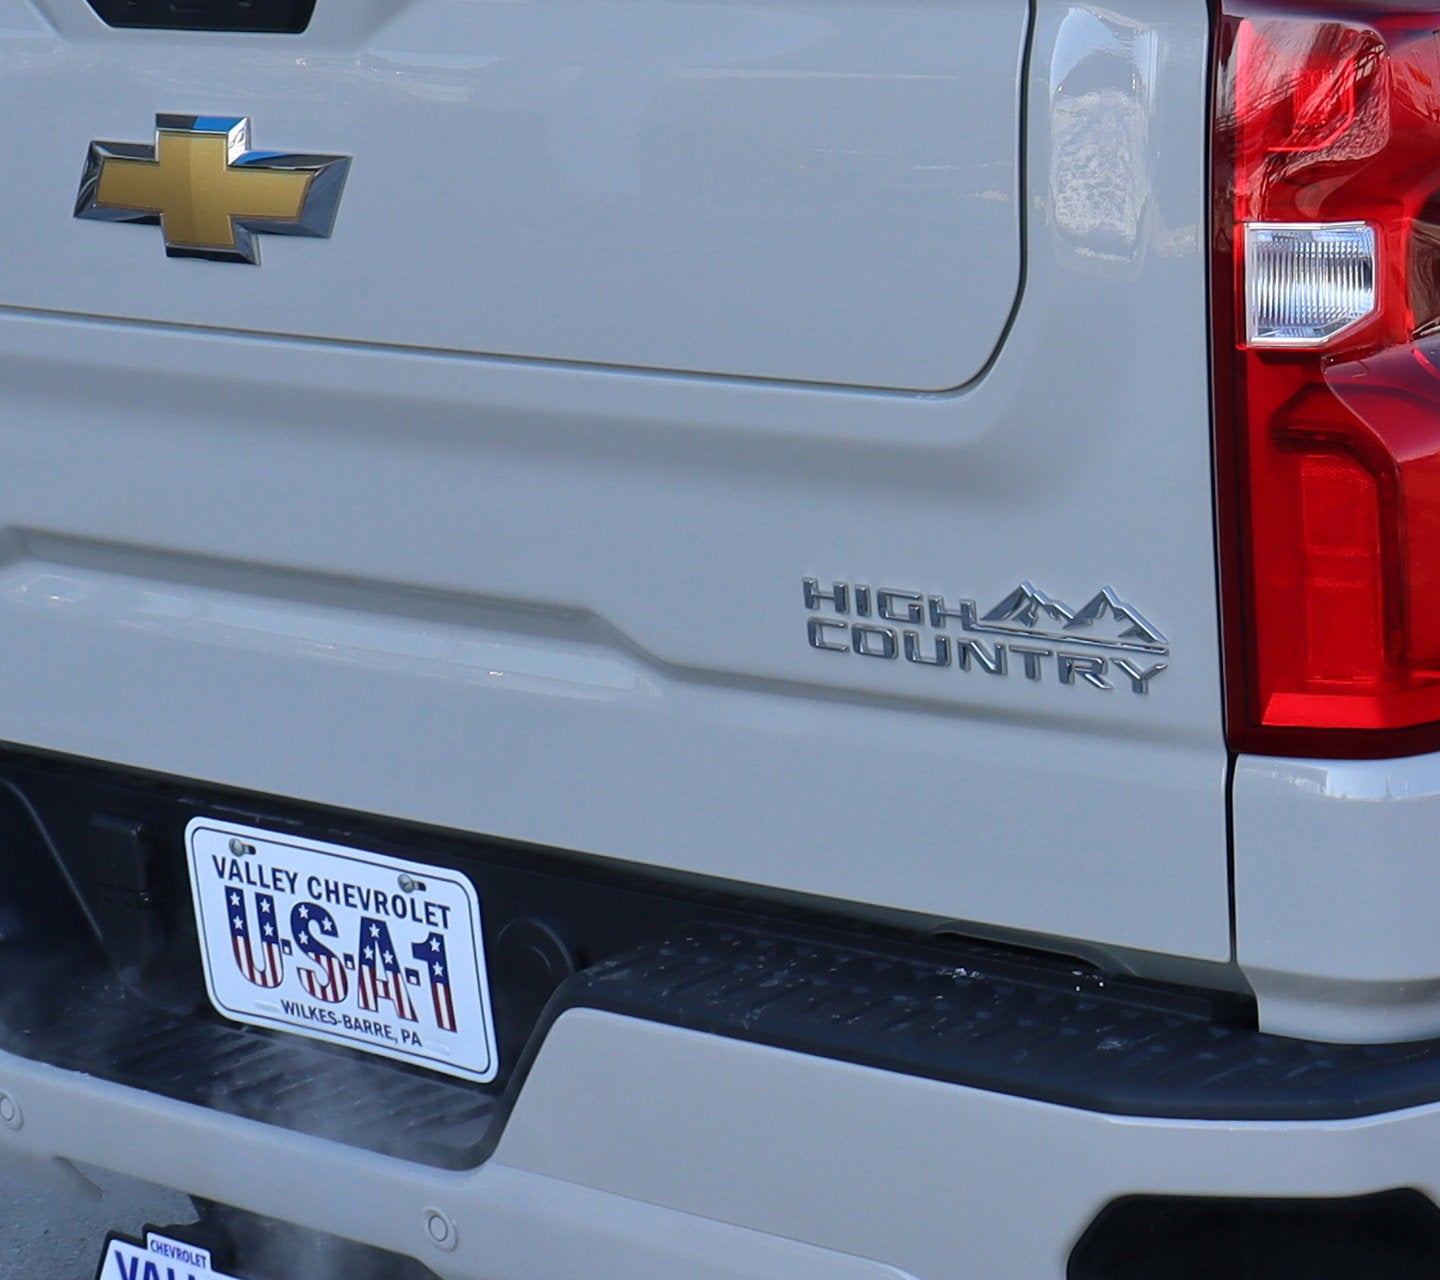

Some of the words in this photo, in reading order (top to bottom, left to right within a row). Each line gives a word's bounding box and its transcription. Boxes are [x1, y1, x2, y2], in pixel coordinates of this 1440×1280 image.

[802, 576, 978, 631] HIGH
[807, 617, 1168, 695] COUNTRY
[211, 854, 298, 894] VALLEY
[307, 875, 450, 929] CHEVROLET
[280, 999, 398, 1044] WILKES-BARRE,
[401, 1029, 422, 1047] PA
[150, 1239, 207, 1269] CHEVROLET
